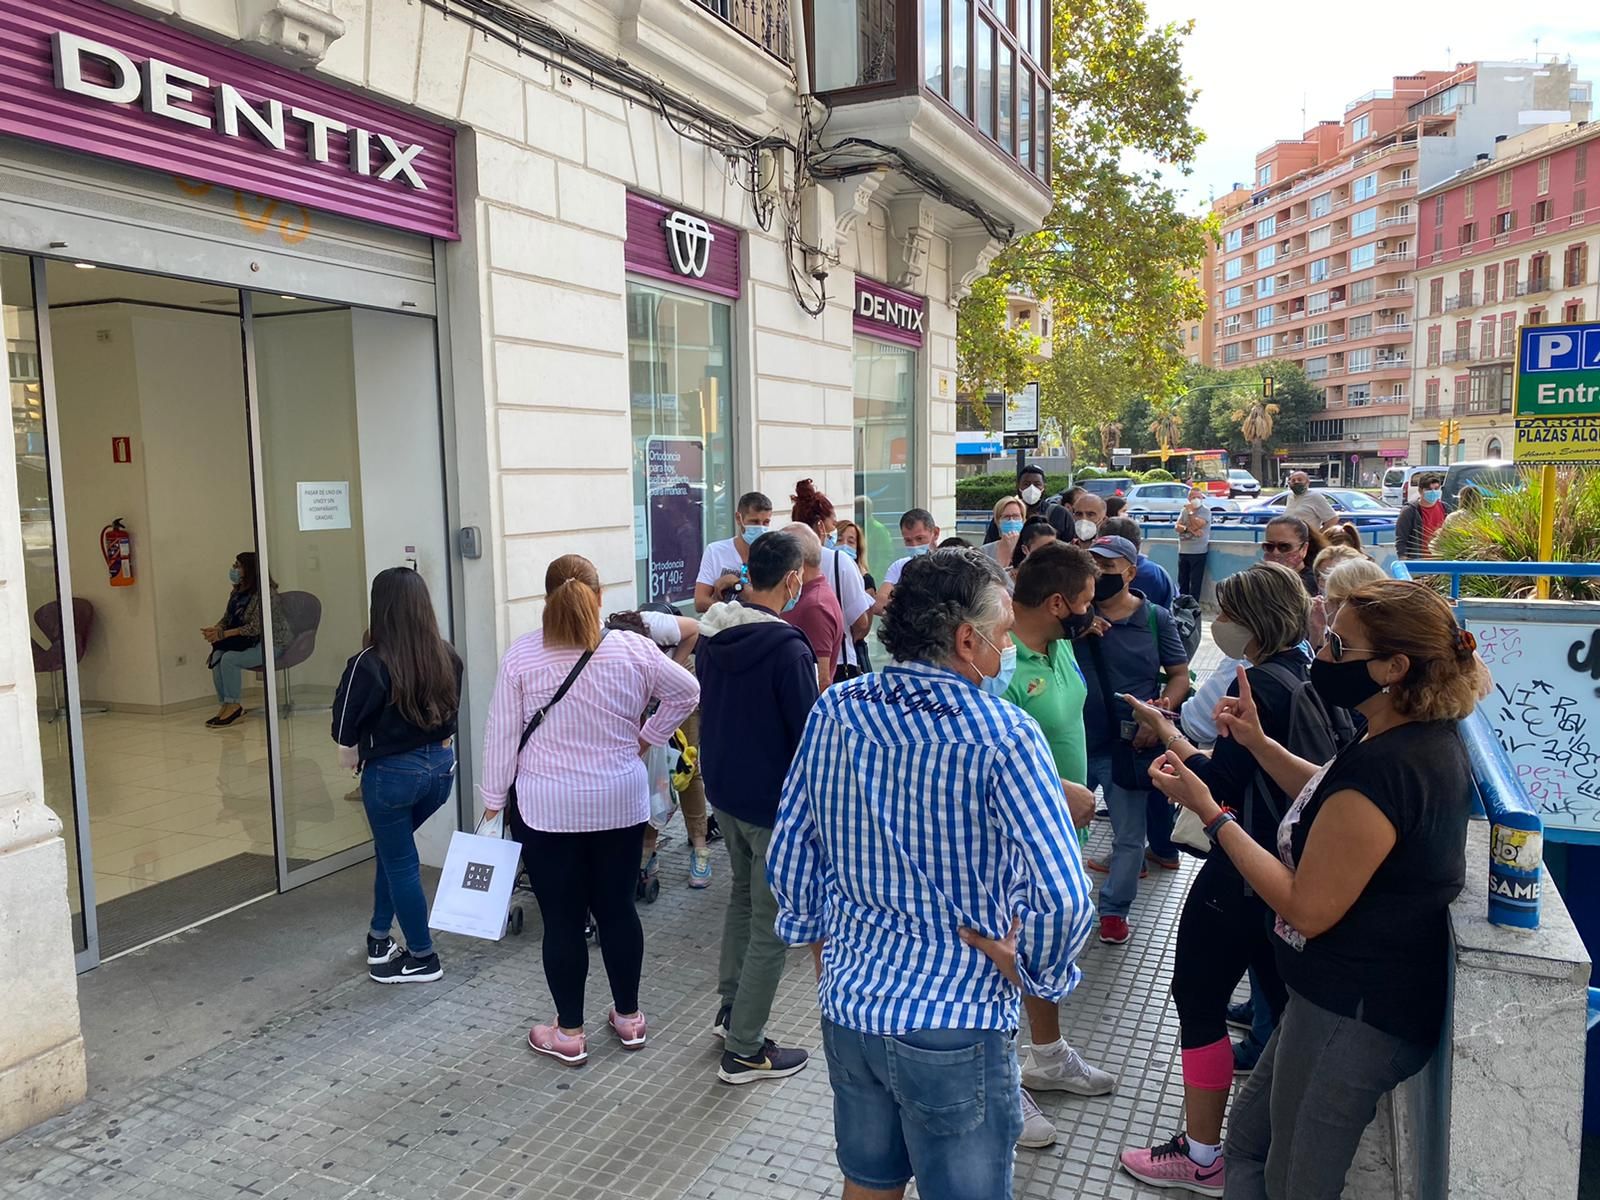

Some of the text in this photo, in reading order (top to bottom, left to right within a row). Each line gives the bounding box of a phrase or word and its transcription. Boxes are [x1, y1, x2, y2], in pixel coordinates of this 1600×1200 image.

[52, 31, 428, 190] DENTIX
[860, 291, 924, 333] DENTIX
[1538, 335, 1573, 368] P
[1537, 383, 1600, 405] Entr
[1518, 427, 1600, 443] PLAZAS ALQ
